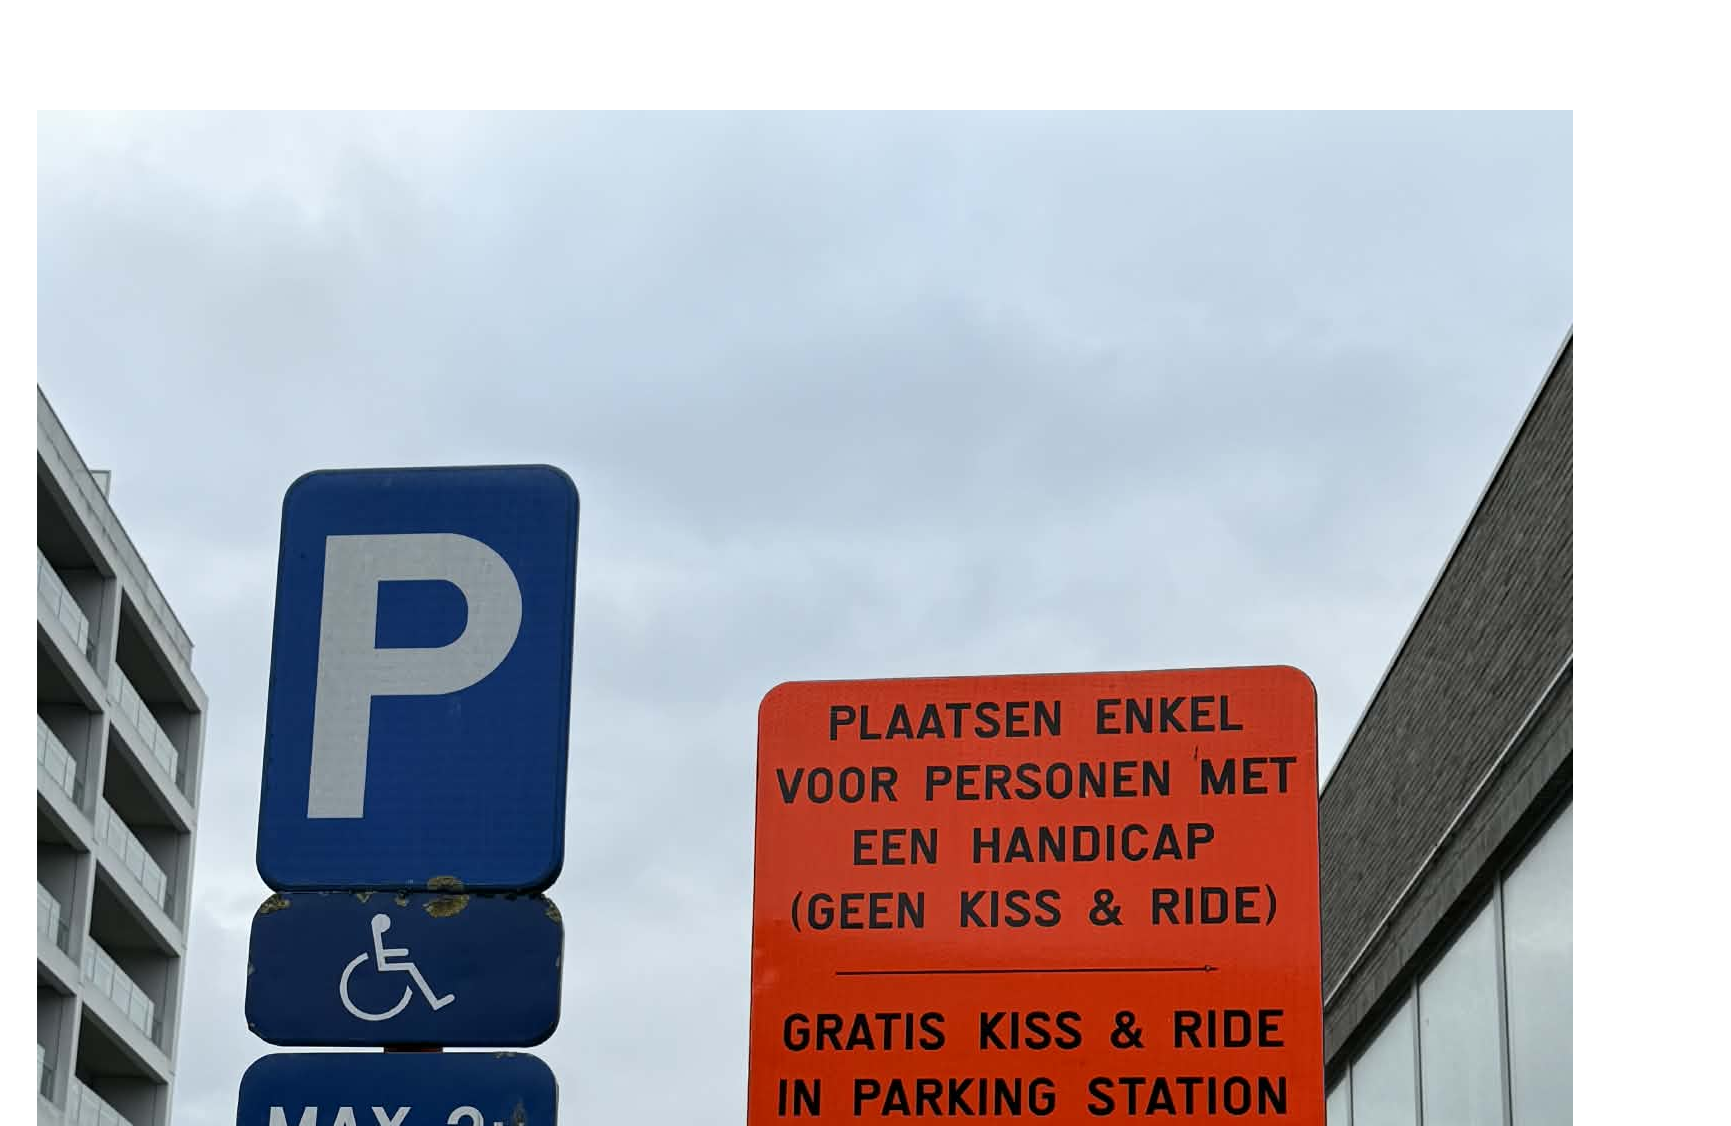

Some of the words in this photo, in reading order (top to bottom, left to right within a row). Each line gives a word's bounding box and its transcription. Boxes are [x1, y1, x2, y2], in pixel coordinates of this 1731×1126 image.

[306, 532, 522, 819] P
[830, 702, 1060, 741] PLAATSEN
[1097, 696, 1244, 735] ENKEL
[777, 767, 898, 804] VOOR
[926, 761, 1170, 801] PERSONEN
[1201, 757, 1297, 796] MET
[854, 829, 938, 866] EEN
[974, 823, 1215, 864] HANDICAP
[791, 892, 925, 932] (GEEN
[961, 890, 1061, 928] KISS
[1089, 889, 1123, 927] &
[1153, 885, 1277, 926] RIDE)
[784, 1012, 946, 1052] GRATIS
[980, 1011, 1082, 1050] KISS
[1111, 1010, 1144, 1049] &
[1175, 1010, 1284, 1049] RIDE
[779, 1078, 821, 1117] IN
[854, 1077, 1056, 1117] PARKING
[1088, 1076, 1287, 1117] STATION
